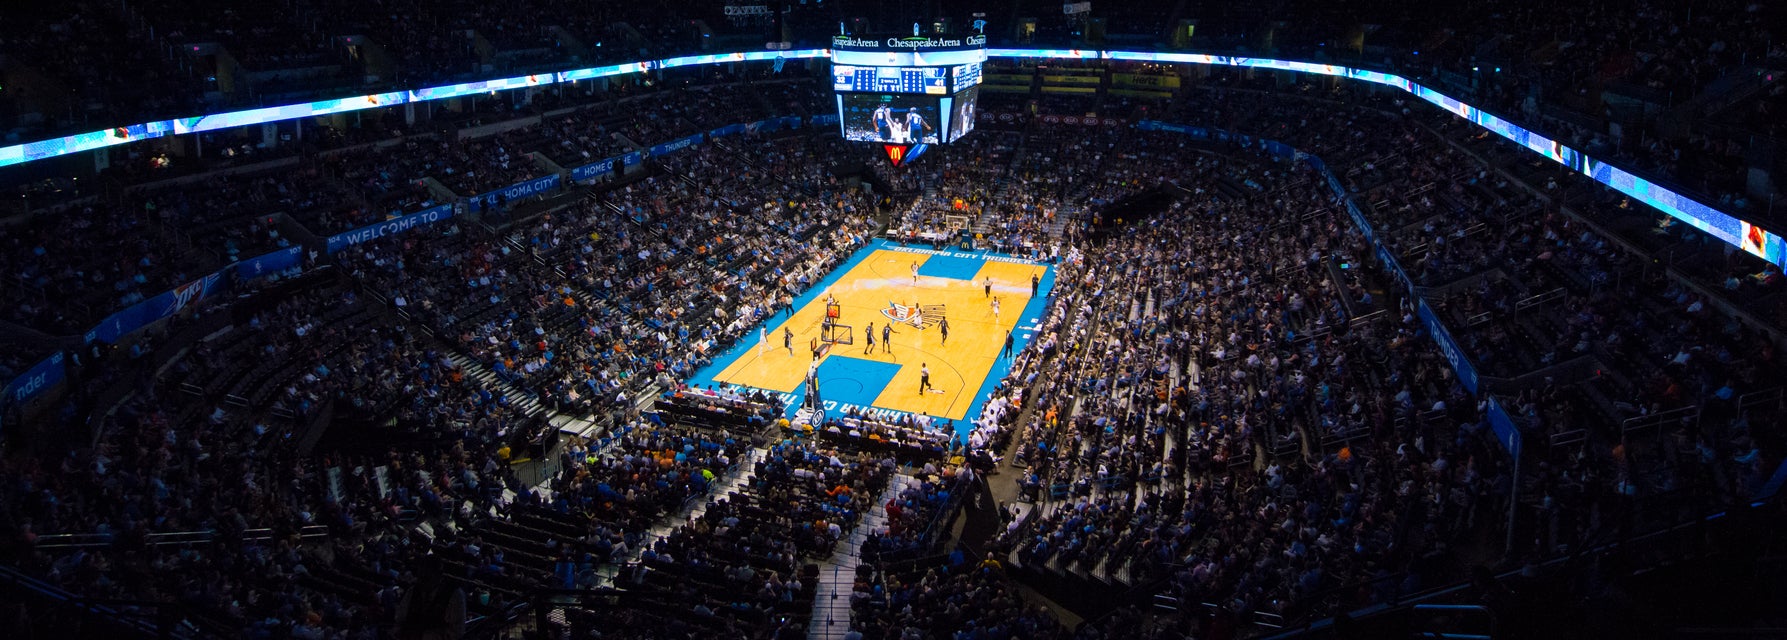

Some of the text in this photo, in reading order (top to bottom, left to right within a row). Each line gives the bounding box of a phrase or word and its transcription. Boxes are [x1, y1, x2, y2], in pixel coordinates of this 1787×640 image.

[857, 38, 879, 47] Arena
[887, 37, 961, 50] Chesapeake Arena
[1132, 75, 1158, 86] Hertz
[664, 138, 691, 152] THUNDER
[584, 162, 606, 176] HOME
[534, 177, 554, 191] CITY
[421, 211, 438, 223] TO
[953, 251, 979, 259] CITY
[1430, 319, 1460, 371] THUNDER
